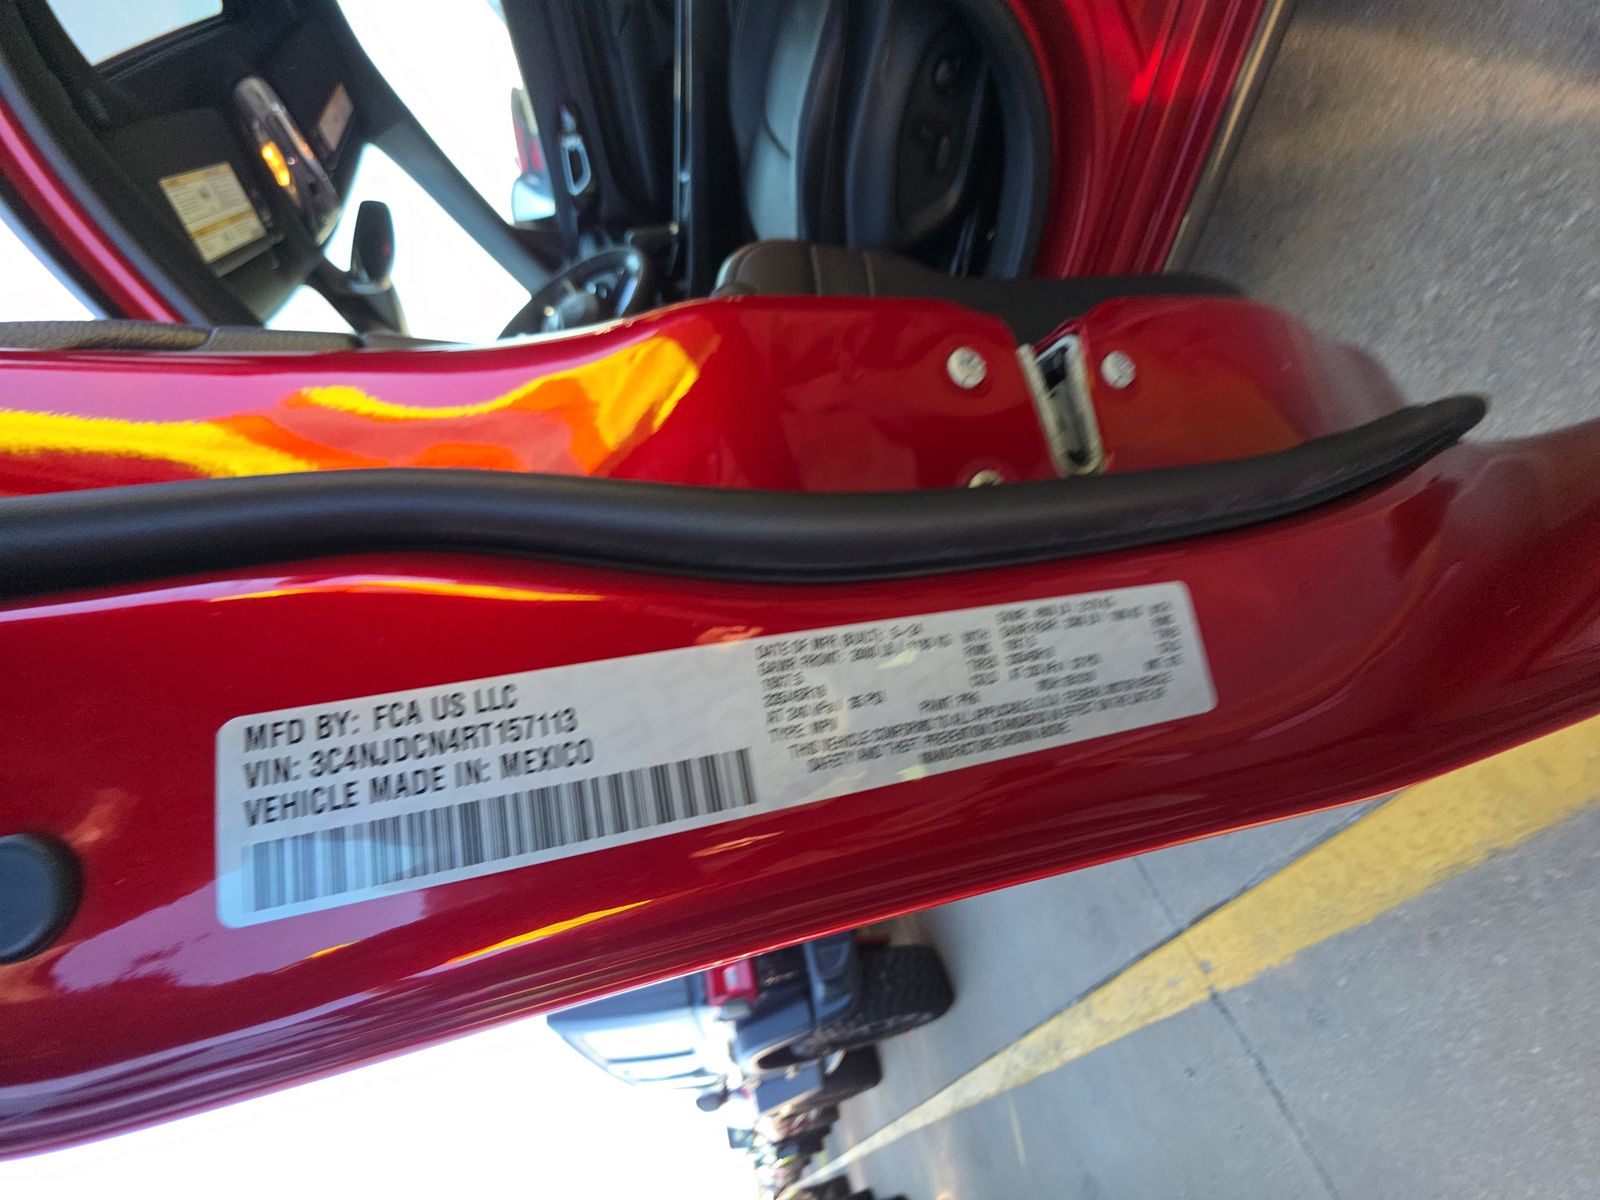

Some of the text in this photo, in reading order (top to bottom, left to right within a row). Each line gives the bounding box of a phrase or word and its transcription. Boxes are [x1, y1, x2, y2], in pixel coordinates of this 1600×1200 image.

[242, 706, 579, 789] VIN: 3C4NJDCN4RT157113
[244, 683, 518, 752] MFD BY: FCA US LLC
[242, 737, 595, 827] VEHICLE MADE IN: MEXICO
